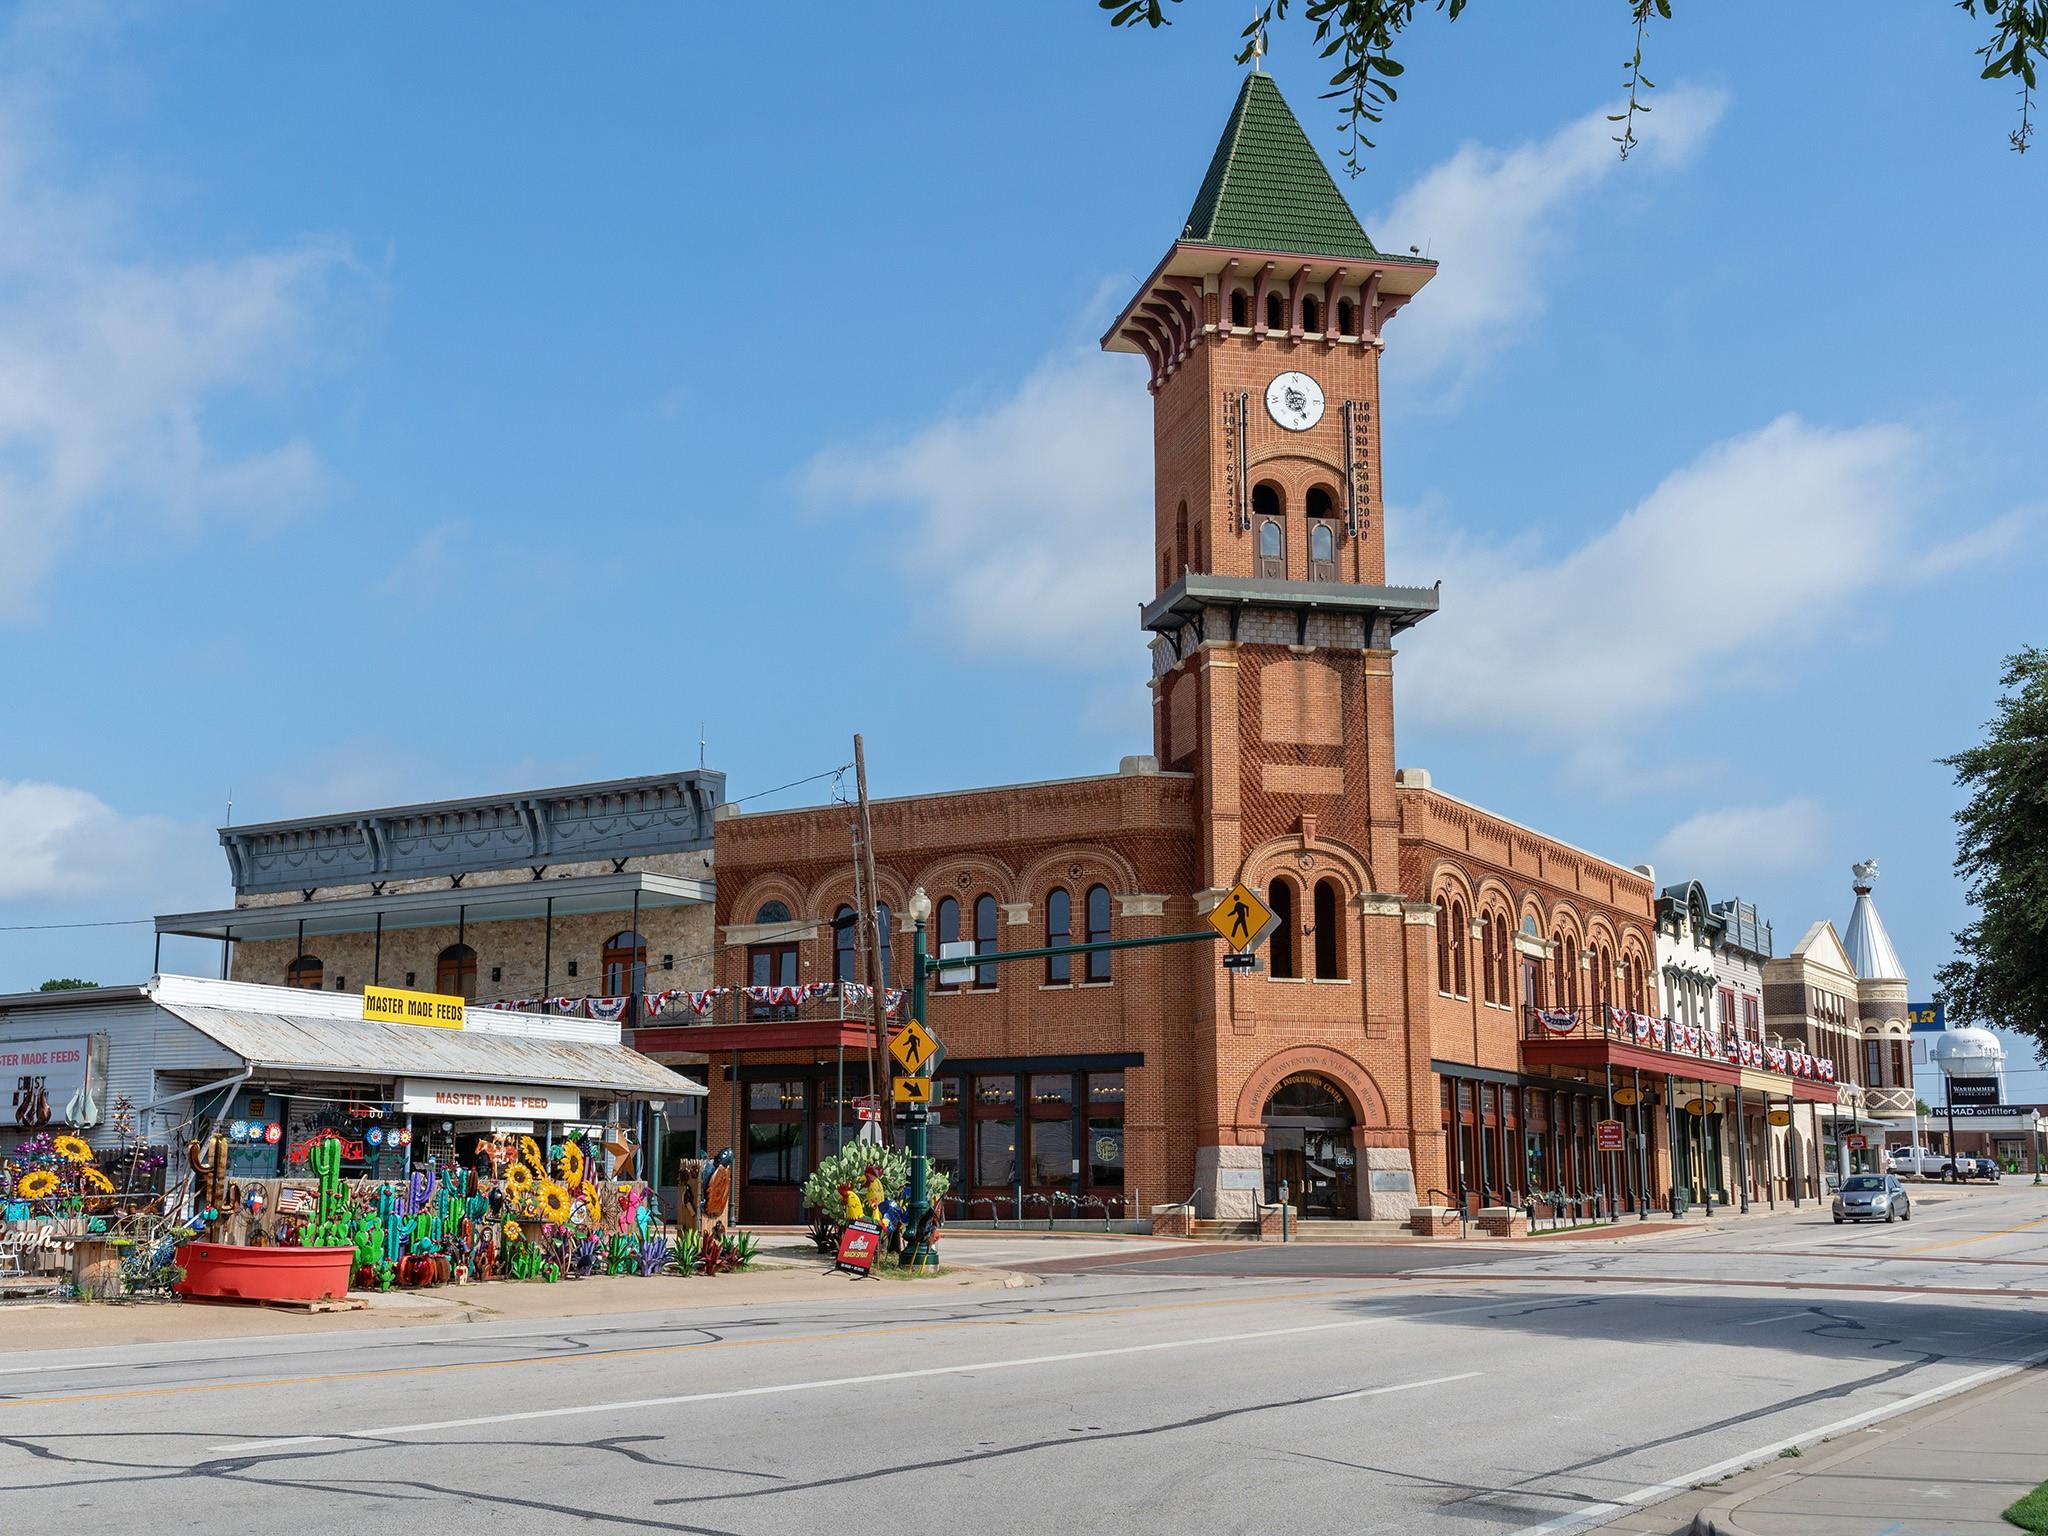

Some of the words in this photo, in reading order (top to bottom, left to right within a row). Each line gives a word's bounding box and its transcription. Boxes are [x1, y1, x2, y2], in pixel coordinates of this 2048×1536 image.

[1292, 375, 1299, 383] N
[1223, 392, 1234, 402] 12
[1271, 394, 1279, 404] W
[1223, 404, 1233, 413] 11
[1353, 401, 1370, 411] 110
[1223, 416, 1235, 425] 10
[1293, 418, 1299, 426] S
[1353, 413, 1370, 423] 100
[1226, 427, 1232, 437] 9
[1356, 425, 1368, 434] 90
[1226, 439, 1232, 449] 8
[1356, 436, 1368, 446] 80
[1226, 451, 1232, 460] 7
[1356, 448, 1368, 458] 70
[1226, 463, 1232, 472] 6
[1227, 474, 1233, 485] 5
[1356, 472, 1369, 481] 50
[1227, 487, 1233, 497] 4
[1357, 483, 1370, 493] 40
[1227, 499, 1233, 509] 3
[1358, 495, 1370, 505] 30
[1228, 511, 1233, 521] 2
[1358, 507, 1370, 517] 20
[1359, 519, 1370, 528] 10
[1361, 531, 1367, 540] 0
[366, 995, 404, 1014] MASTER
[408, 1000, 433, 1017] MADE
[437, 1004, 463, 1021] FEEDS
[0, 1053, 19, 1067] TER
[21, 1052, 48, 1065] MADE
[51, 1050, 81, 1064] FEEDS
[1249, 1075, 1270, 1118] GRAPEVINE
[1271, 1056, 1319, 1076] CONVENTION
[1330, 1060, 1361, 1086] VISITORS
[1361, 1087, 1378, 1119] BUREAU
[1284, 1075, 1322, 1087] INFORMATION
[1323, 1083, 1344, 1104] CENTER
[436, 1092, 481, 1106] MASTER
[486, 1095, 516, 1108] MADE
[521, 1097, 548, 1109] FEED
[1976, 1106, 2017, 1116] outfitters
